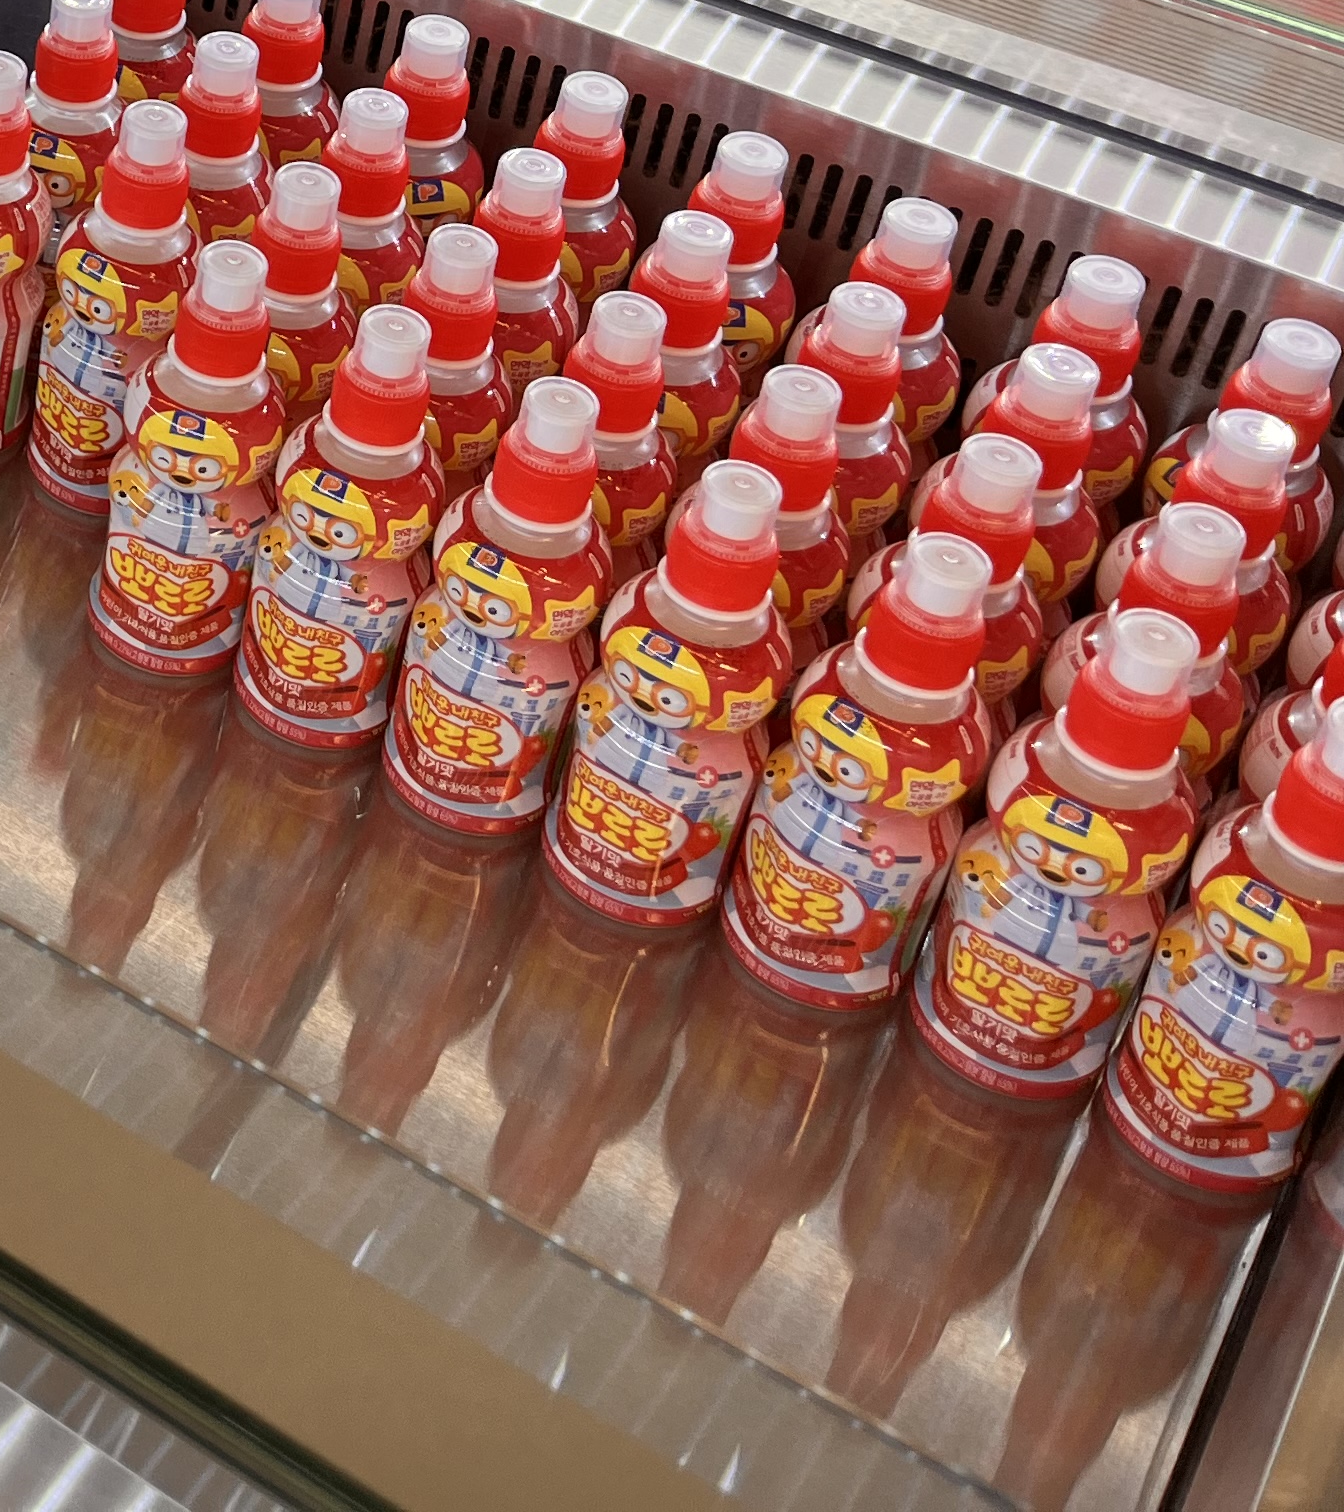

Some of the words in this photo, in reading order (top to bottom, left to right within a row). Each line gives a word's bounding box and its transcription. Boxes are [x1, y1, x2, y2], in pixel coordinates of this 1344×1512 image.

[37, 376, 110, 453] 뽀로로
[68, 395, 106, 417] 내친구
[61, 462, 95, 479] 품질인증
[110, 546, 215, 616] 뽀로로
[128, 538, 169, 573] 귀여운
[169, 563, 214, 579] 내친구
[137, 606, 176, 633] 딸기맛
[256, 599, 347, 683] 뽀로로
[268, 594, 296, 634] 귀여운
[297, 625, 346, 645] 내친구
[267, 667, 303, 696] 딸기맛
[286, 699, 329, 714] 품질인증
[331, 701, 352, 711] 제품
[421, 671, 451, 715] 귀여운
[451, 703, 502, 729] 내친구
[410, 678, 502, 767] 뽀로로
[417, 748, 455, 778] 딸기맛
[578, 758, 619, 801] 귀여운
[620, 790, 671, 823] 내친구
[567, 775, 672, 863] 뽀로로
[564, 840, 600, 873] 기호식품
[603, 866, 648, 890] 품질인증
[580, 834, 623, 868] 딸기맛
[750, 828, 844, 935] 뽀로로
[789, 861, 844, 895] 내친구
[755, 903, 791, 941] 딸기맛
[950, 935, 1076, 1035] 뽀로로
[968, 930, 1023, 975] 귀여운
[1023, 963, 1079, 996] 내친구
[970, 1007, 1019, 1043] 딸기맛
[1160, 1007, 1198, 1059] 귀여운
[1198, 1048, 1256, 1080] 내친구
[1139, 1011, 1253, 1119] 뽀로로
[1136, 1092, 1169, 1133] 기호식품
[1170, 1128, 1221, 1150] 품질인증
[1223, 1137, 1250, 1150] 제품
[1153, 1087, 1193, 1131] 딸기맛
